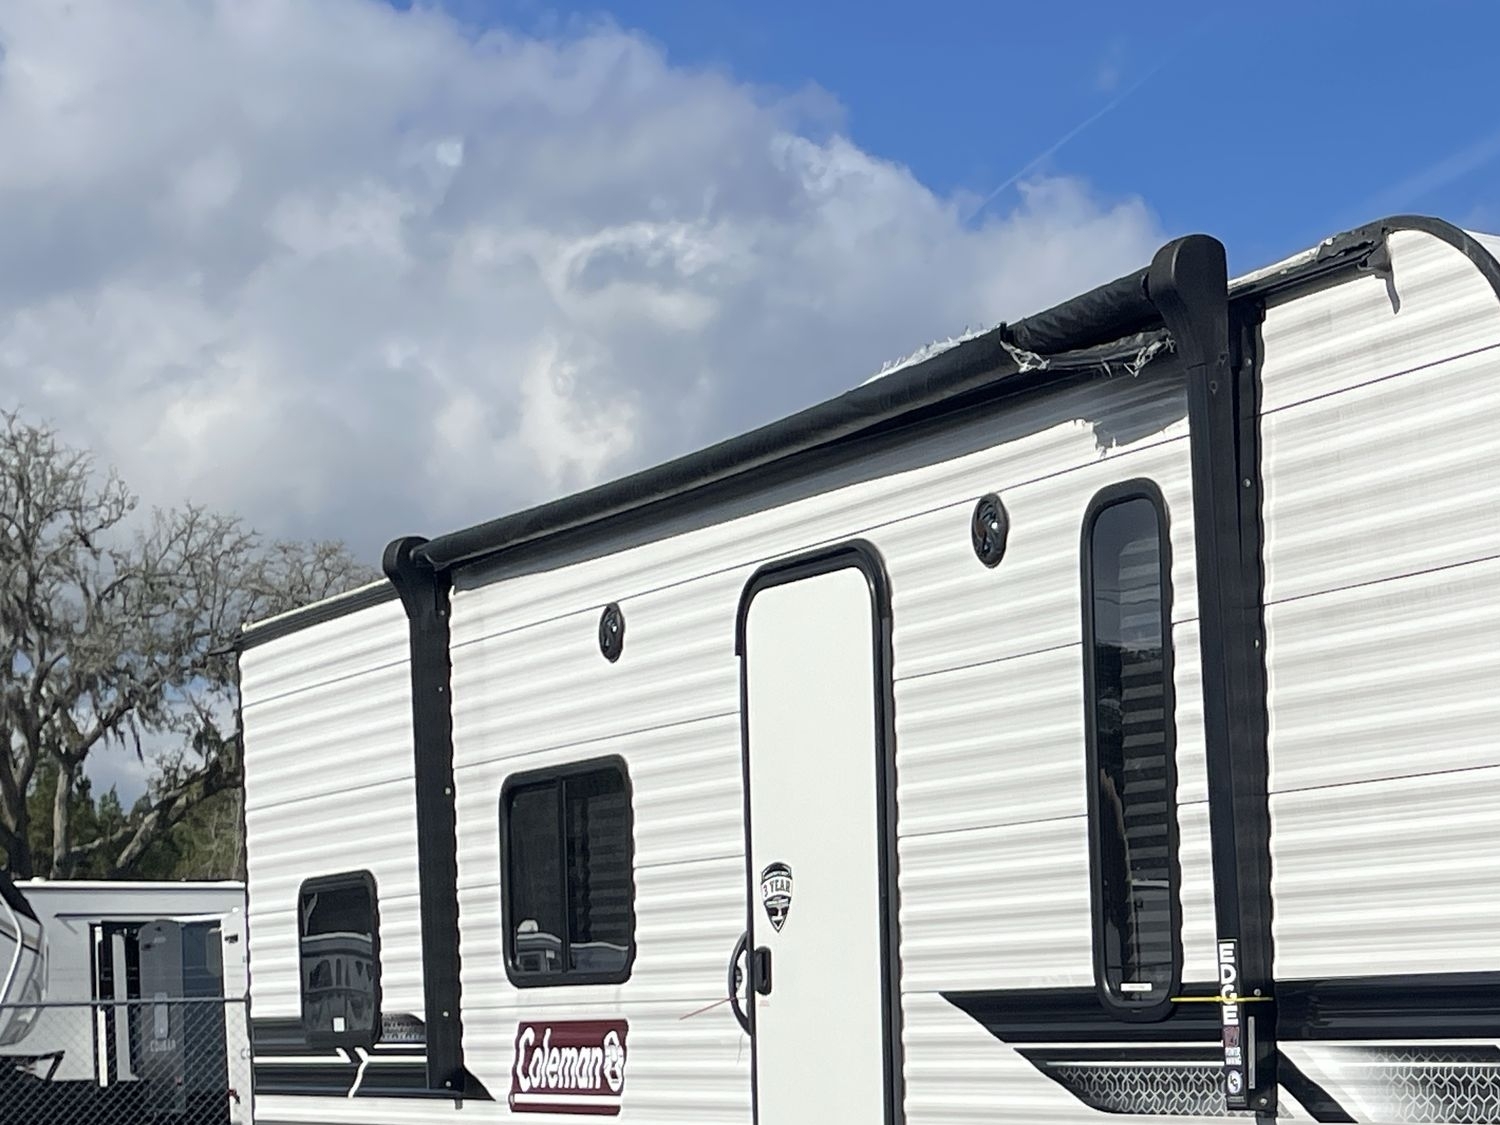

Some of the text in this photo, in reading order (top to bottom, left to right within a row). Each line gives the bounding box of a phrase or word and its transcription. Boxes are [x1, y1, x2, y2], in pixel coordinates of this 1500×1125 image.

[763, 879, 791, 898] 3 YEAR
[1218, 942, 1239, 1026] EDGE
[516, 1026, 603, 1092] Coleman
